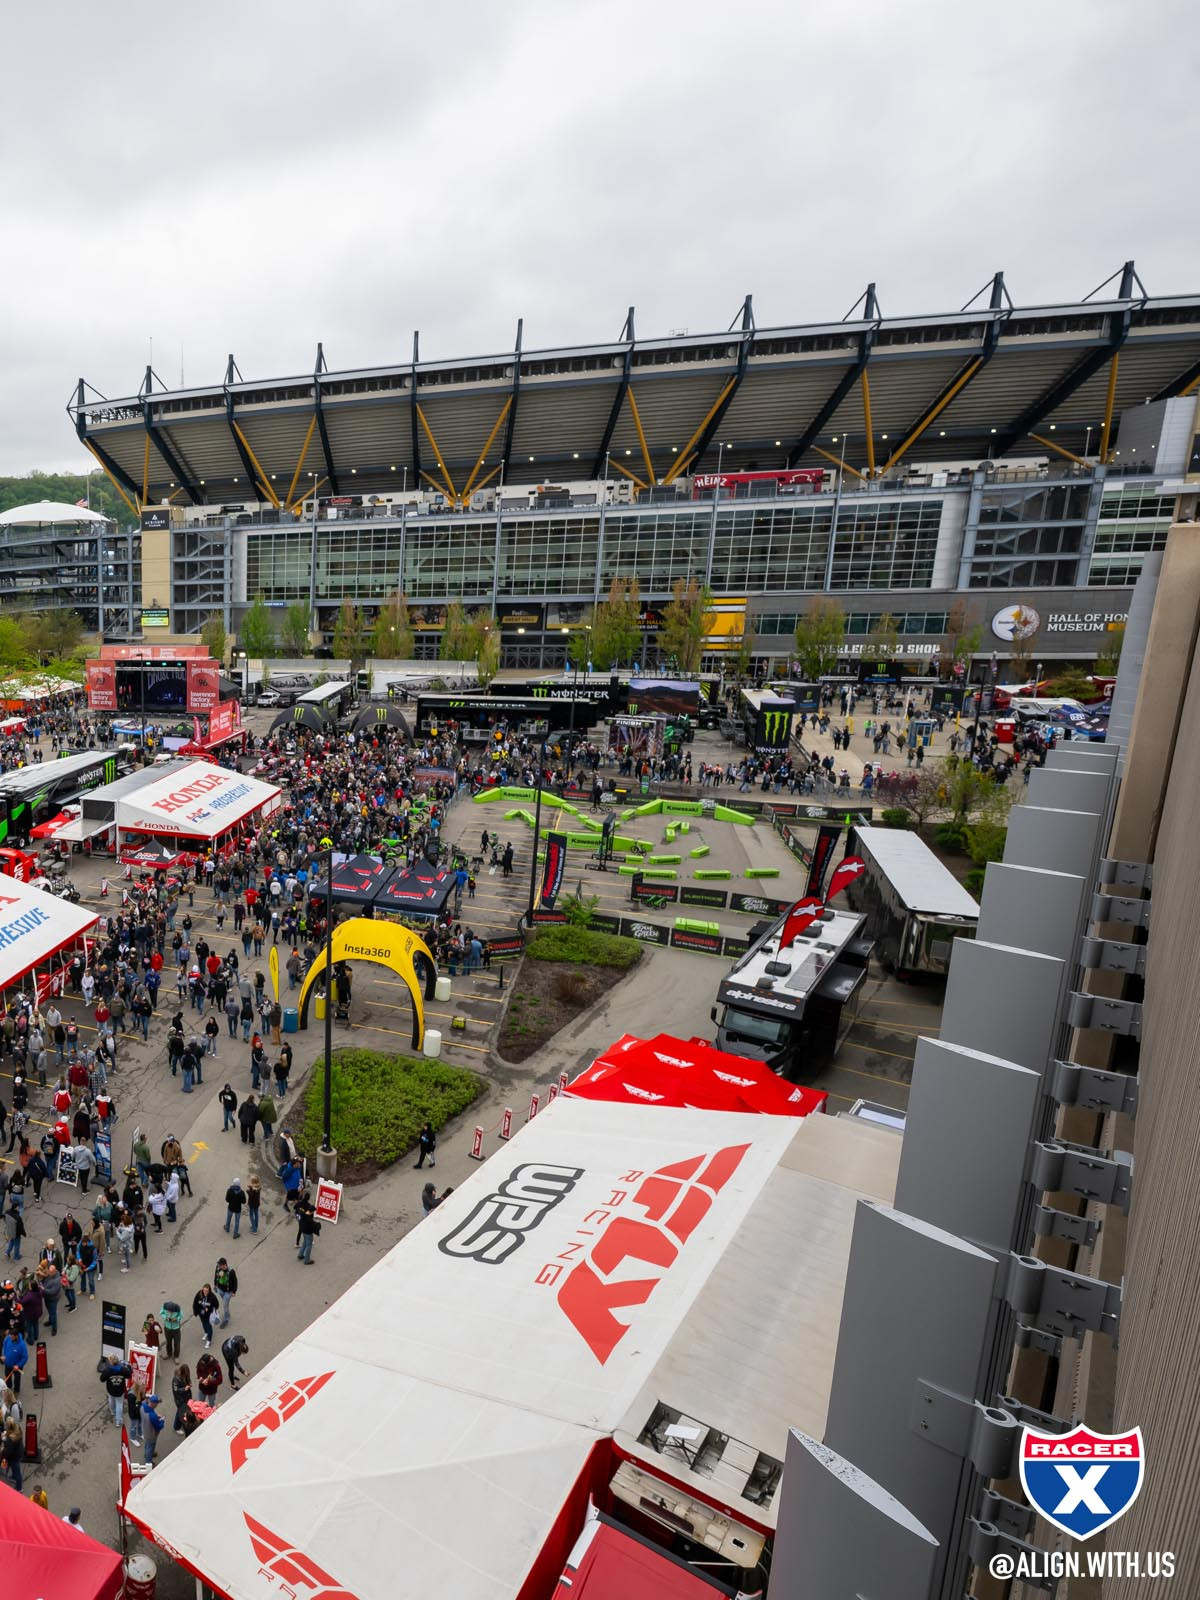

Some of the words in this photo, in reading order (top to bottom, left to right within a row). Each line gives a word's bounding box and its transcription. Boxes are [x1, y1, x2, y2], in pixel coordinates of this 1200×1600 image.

[697, 475, 728, 488] HEINZ
[1048, 614, 1082, 622] HALL
[1084, 614, 1102, 622] OF
[1047, 623, 1104, 632] MUSEUM
[907, 643, 941, 654] SHOP
[78, 768, 105, 785] MONSTER
[152, 774, 230, 813] HONDA
[503, 791, 531, 799] Kawasaki
[666, 805, 699, 813] Kawasaki
[144, 822, 181, 832] HONDA
[571, 838, 603, 846] Kawasak
[674, 933, 720, 946] Kawasaki
[344, 943, 391, 959] Insta360
[726, 989, 797, 1011] alpinestars
[653, 1051, 695, 1068] FLY
[712, 1069, 758, 1086] FLY
[622, 1082, 665, 1100] FLY
[319, 1197, 337, 1206] DEALER
[437, 1163, 586, 1265] WPS
[534, 1168, 643, 1287] RACING
[557, 1142, 753, 1367] FLY
[226, 1380, 290, 1437] RACING
[230, 1370, 336, 1474] FLY
